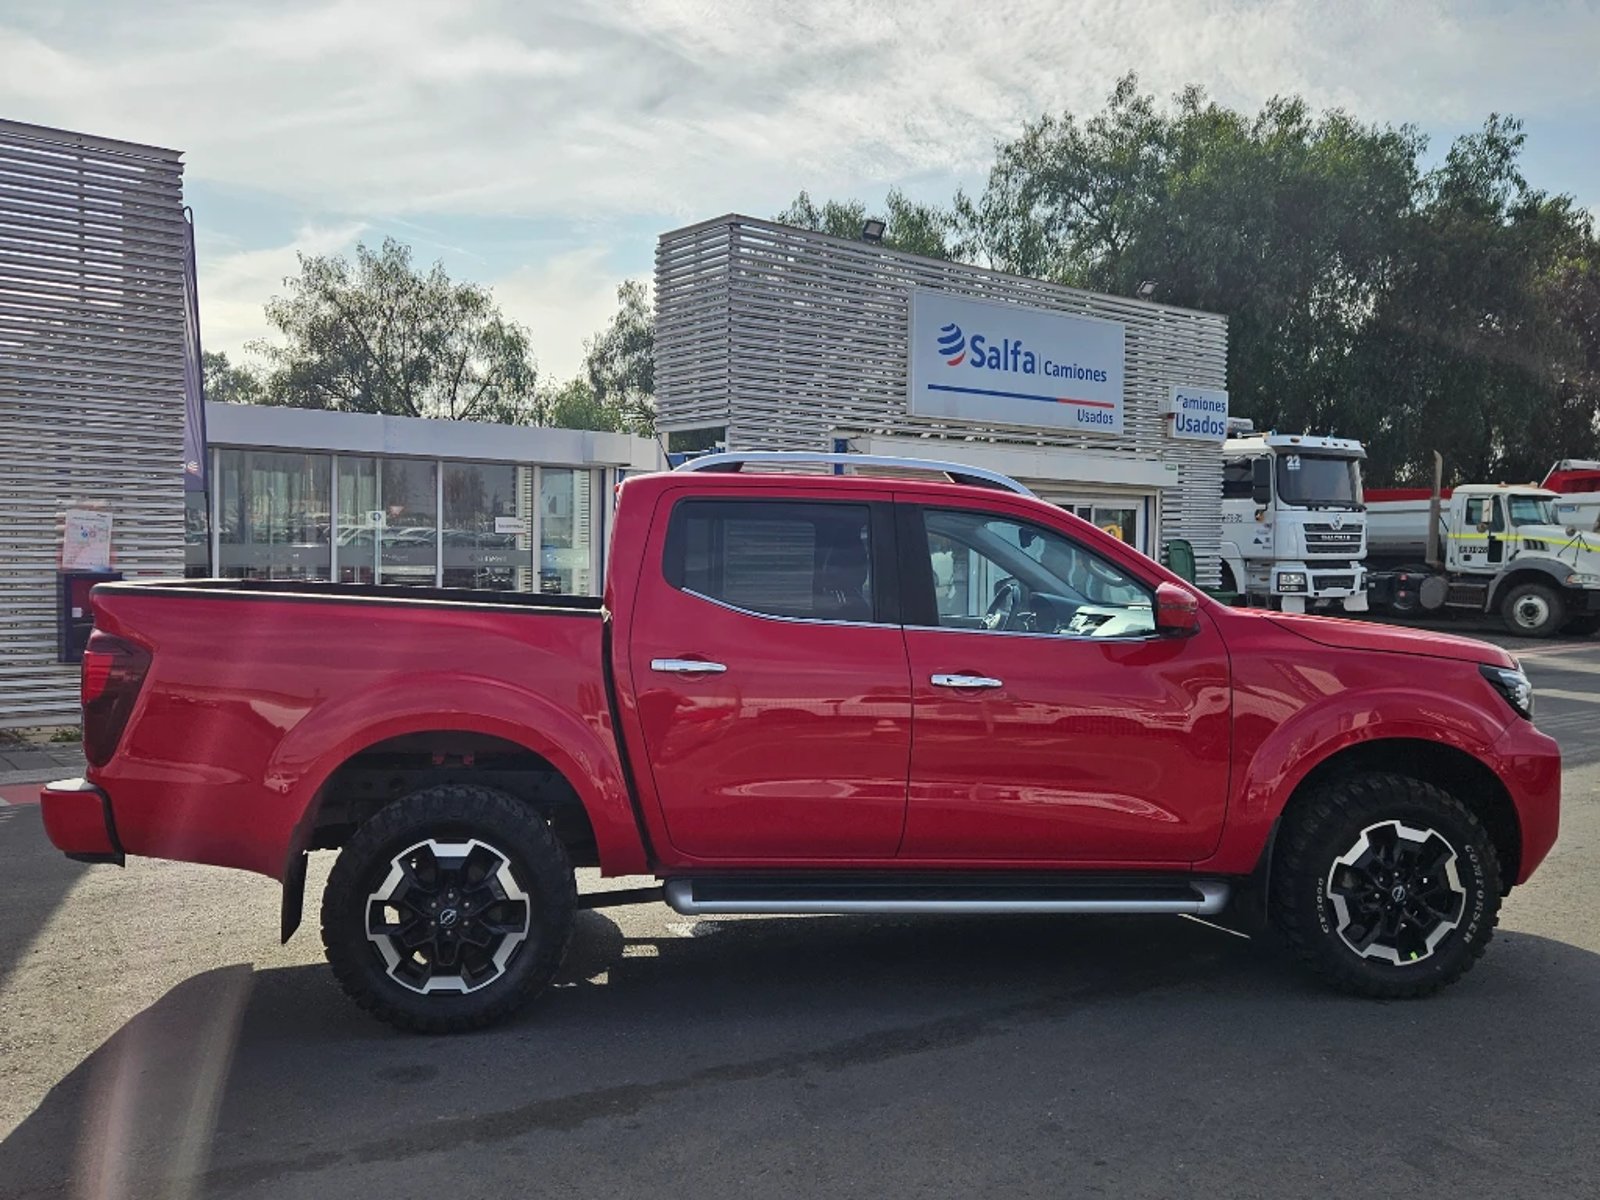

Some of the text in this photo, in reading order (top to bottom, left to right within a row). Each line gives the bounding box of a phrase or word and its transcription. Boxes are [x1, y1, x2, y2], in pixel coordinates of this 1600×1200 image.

[970, 334, 1108, 383] Salfa Camiones
[1077, 408, 1114, 425] Usados
[1176, 413, 1225, 435] Usados
